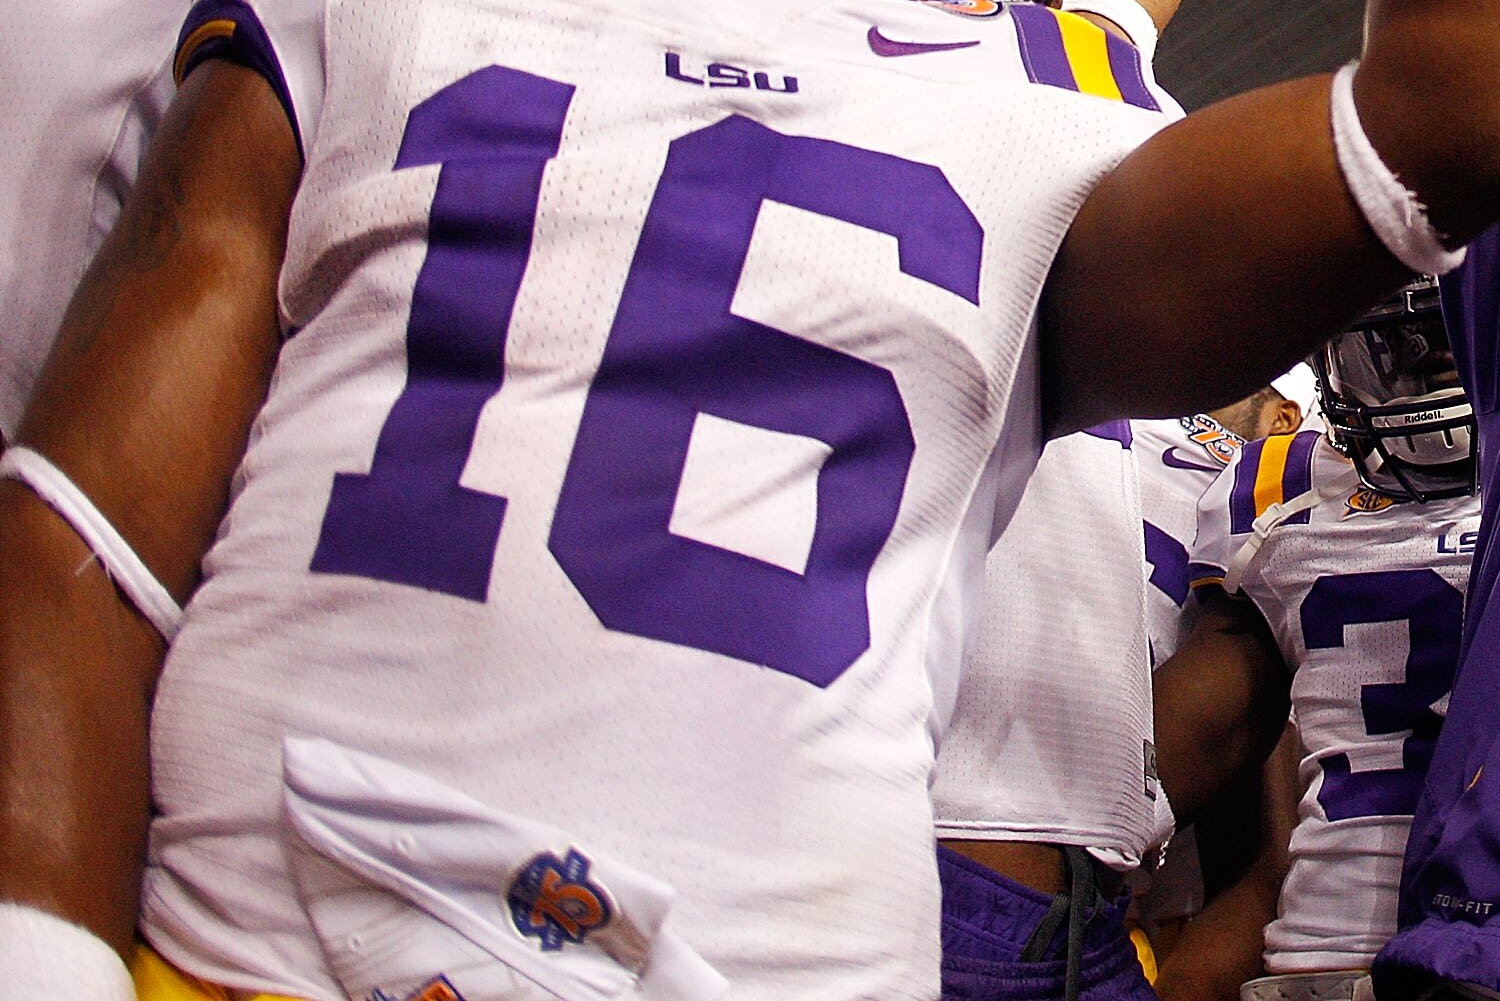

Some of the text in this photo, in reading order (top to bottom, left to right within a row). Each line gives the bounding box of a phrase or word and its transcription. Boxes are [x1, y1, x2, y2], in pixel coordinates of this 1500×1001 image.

[665, 52, 799, 93] LSU
[308, 64, 985, 690] 16
[1436, 531, 1480, 554] LS
